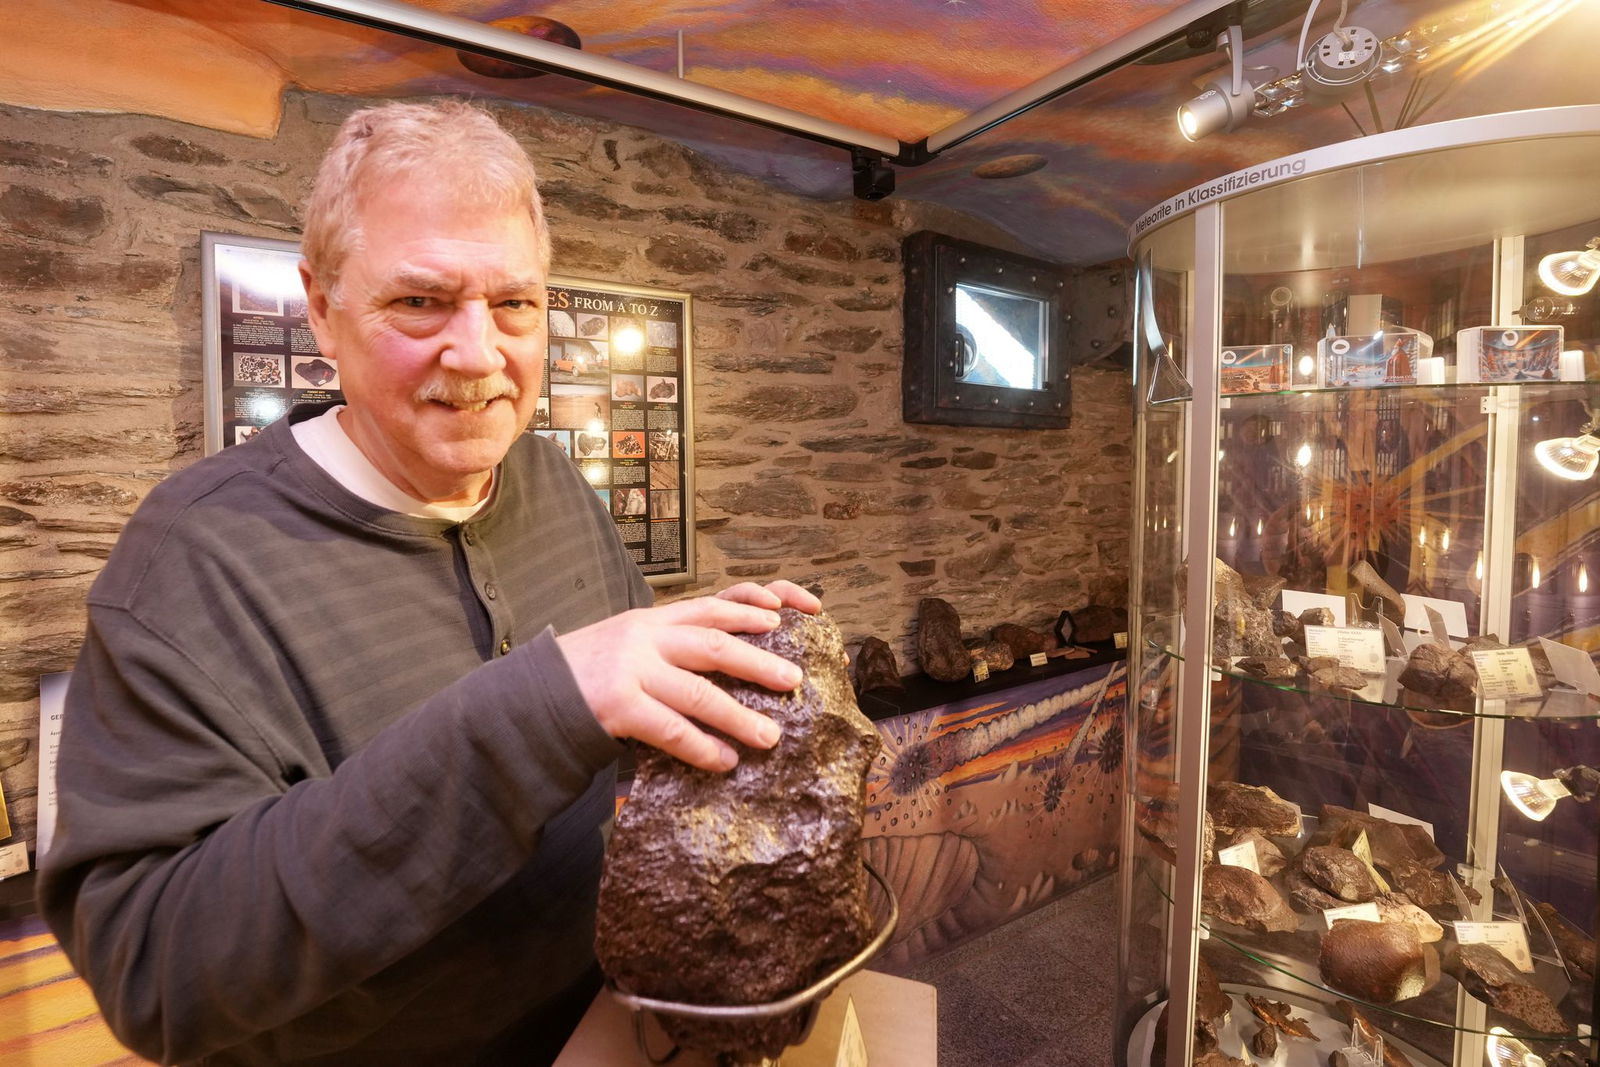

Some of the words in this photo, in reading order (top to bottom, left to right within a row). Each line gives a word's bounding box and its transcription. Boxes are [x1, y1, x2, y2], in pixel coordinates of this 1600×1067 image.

[1135, 204, 1172, 235] Meteorite
[1174, 197, 1185, 212] in
[1188, 158, 1306, 206] Klassifizierung
[547, 290, 570, 309] ES
[574, 296, 614, 312] FROM
[617, 302, 626, 313] A
[630, 303, 647, 315] TO
[650, 305, 659, 317] Z
